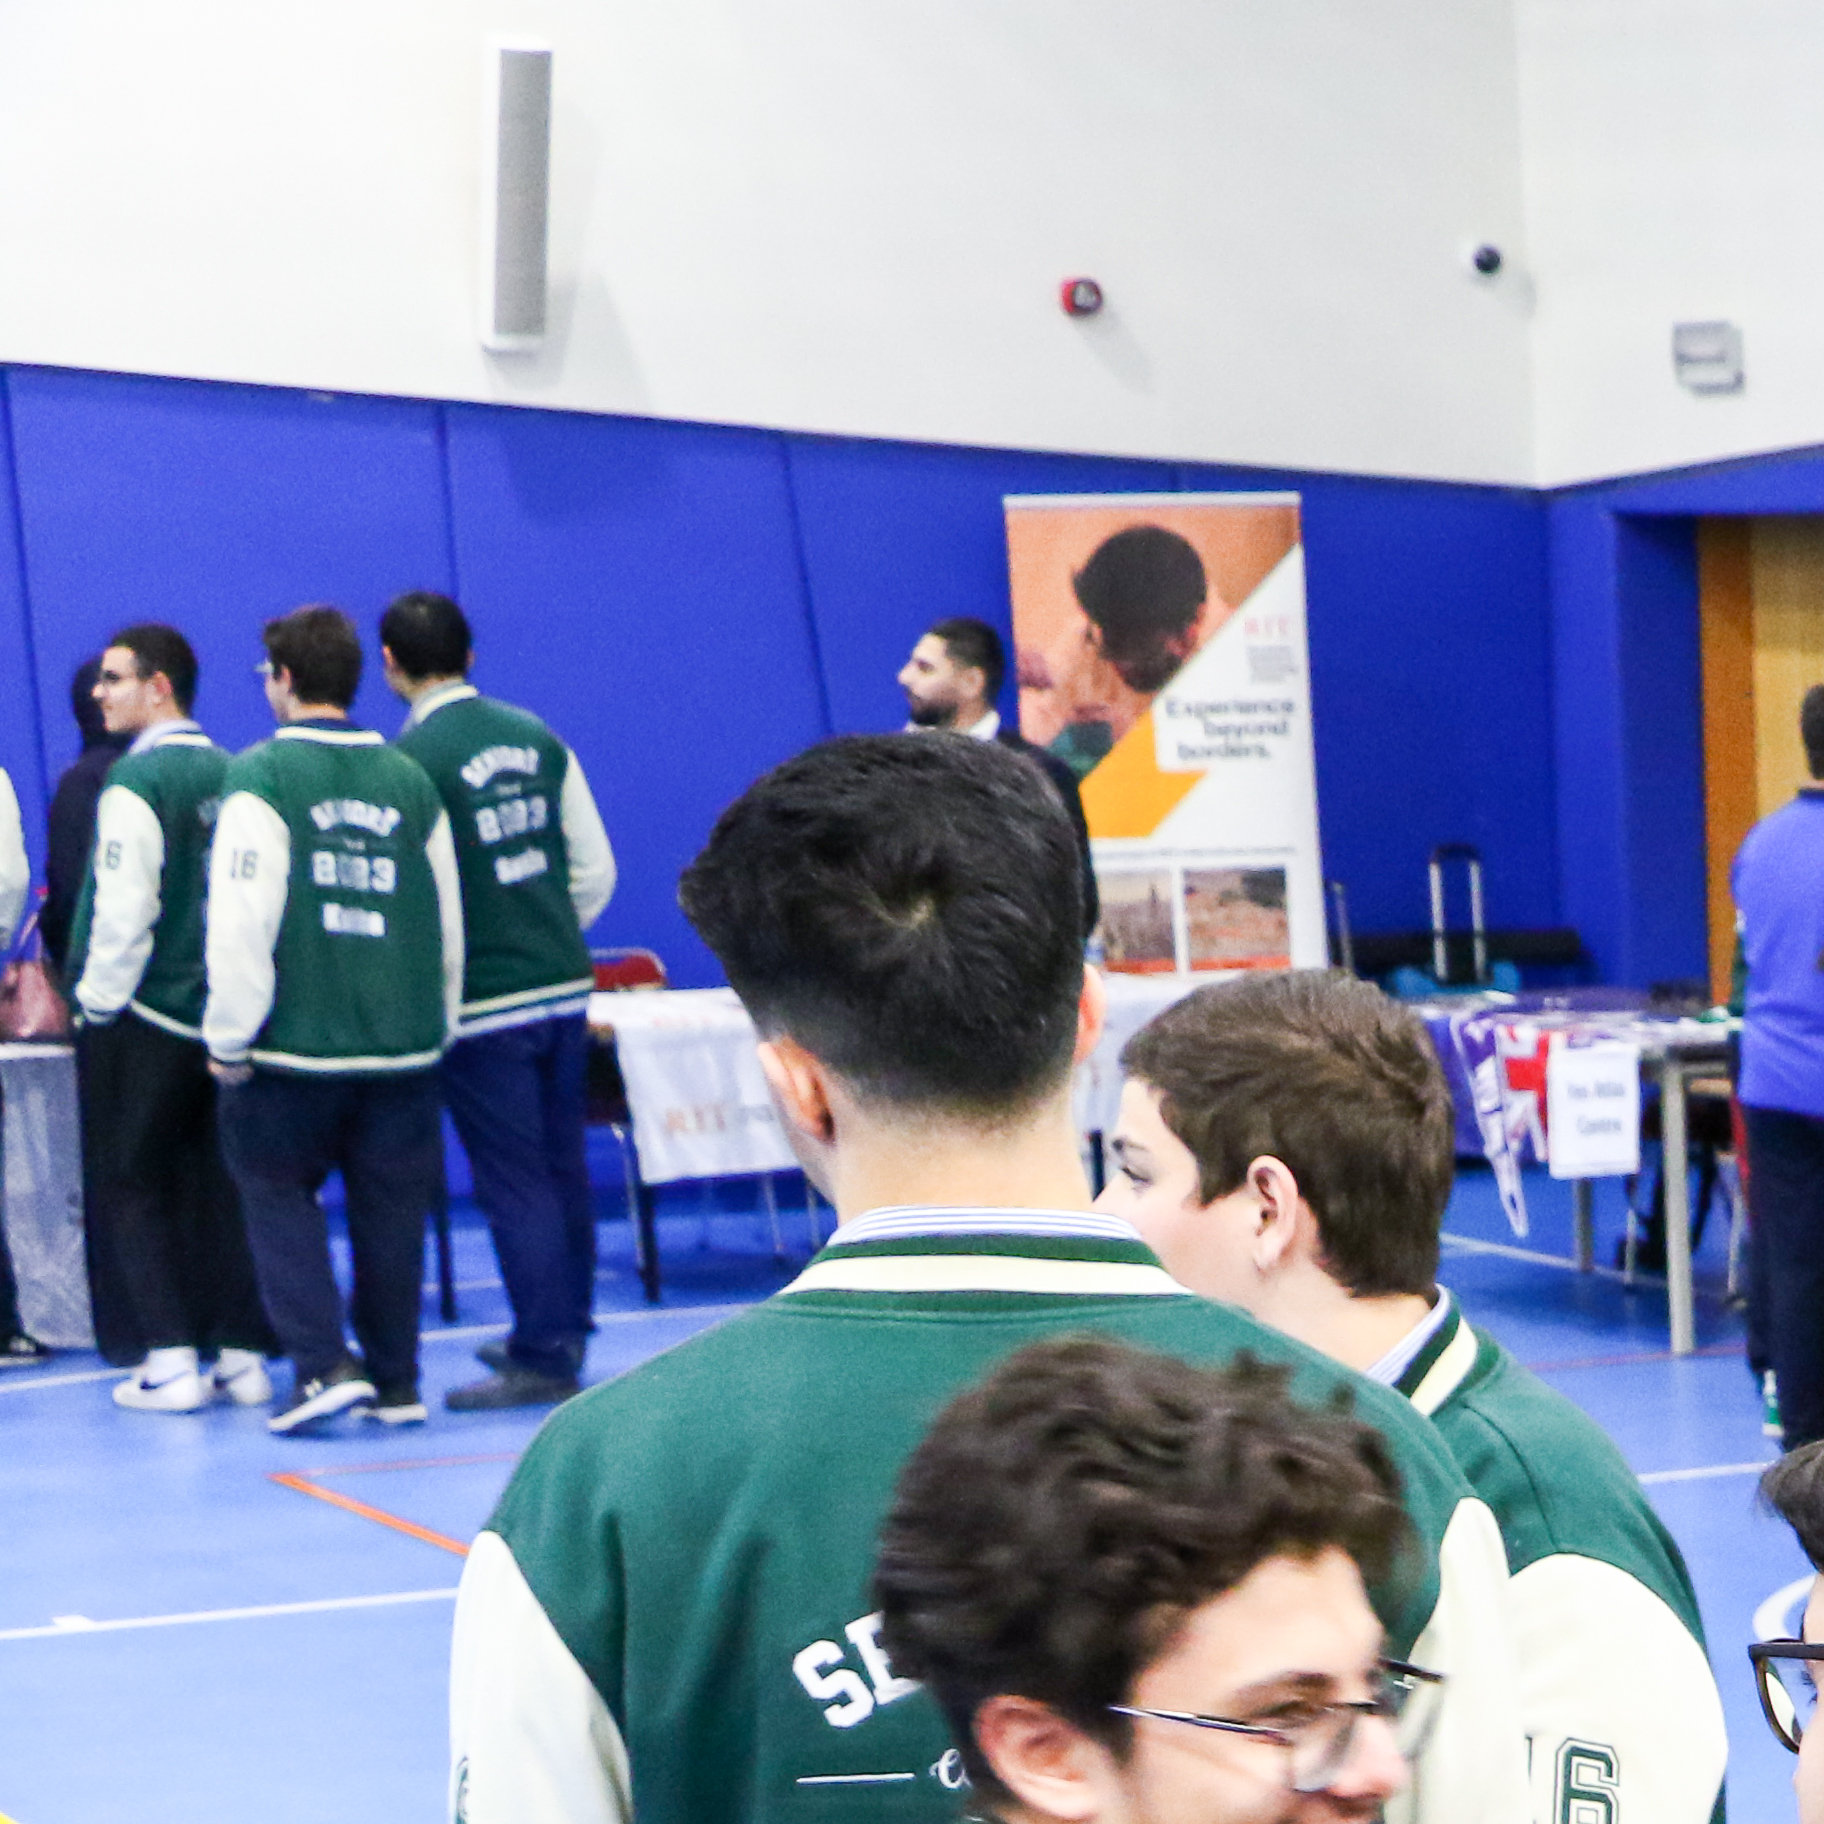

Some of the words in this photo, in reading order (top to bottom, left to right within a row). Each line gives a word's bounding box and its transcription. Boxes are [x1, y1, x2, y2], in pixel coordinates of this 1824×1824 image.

[1165, 697, 1295, 719] Experience
[1204, 720, 1289, 738] beyond
[230, 847, 259, 881] 16
